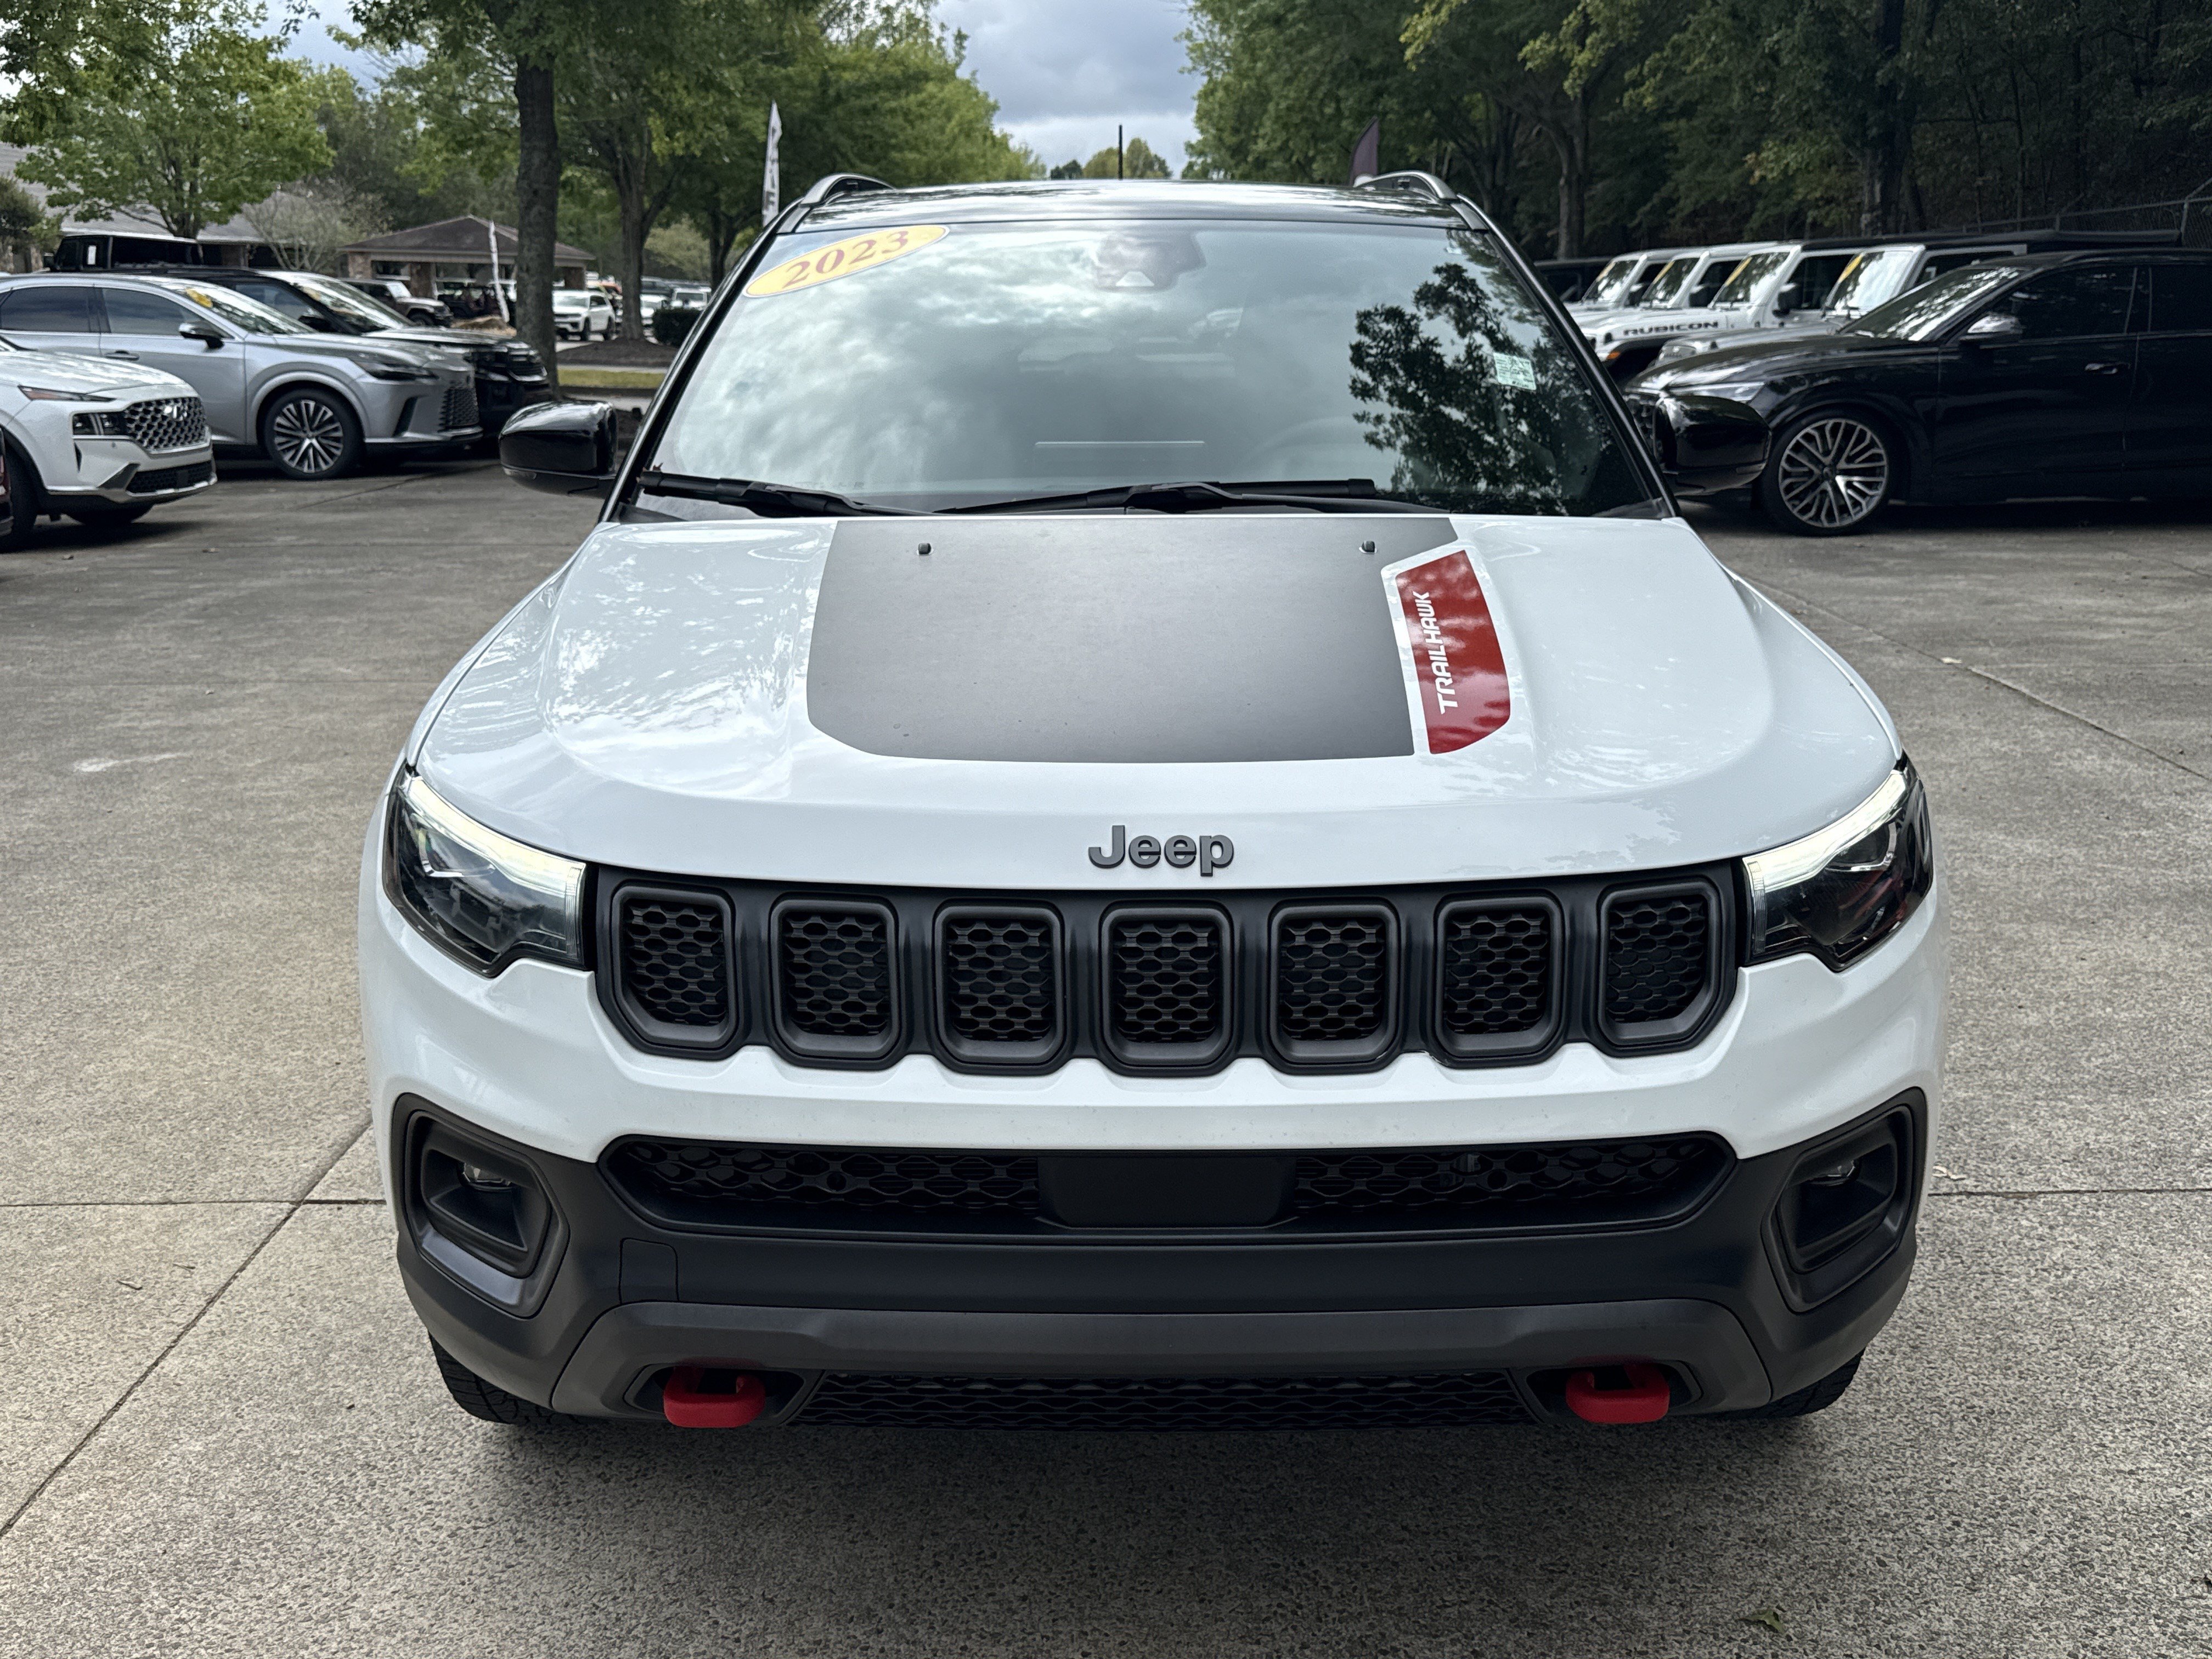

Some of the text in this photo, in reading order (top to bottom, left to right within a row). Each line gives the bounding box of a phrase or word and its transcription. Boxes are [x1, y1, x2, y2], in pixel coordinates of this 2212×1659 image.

[782, 230, 909, 289] 2023
[1623, 321, 1718, 335] RUBICON
[1413, 591, 1458, 715] TRAILHAWK
[1088, 825, 1234, 877] Jeep
